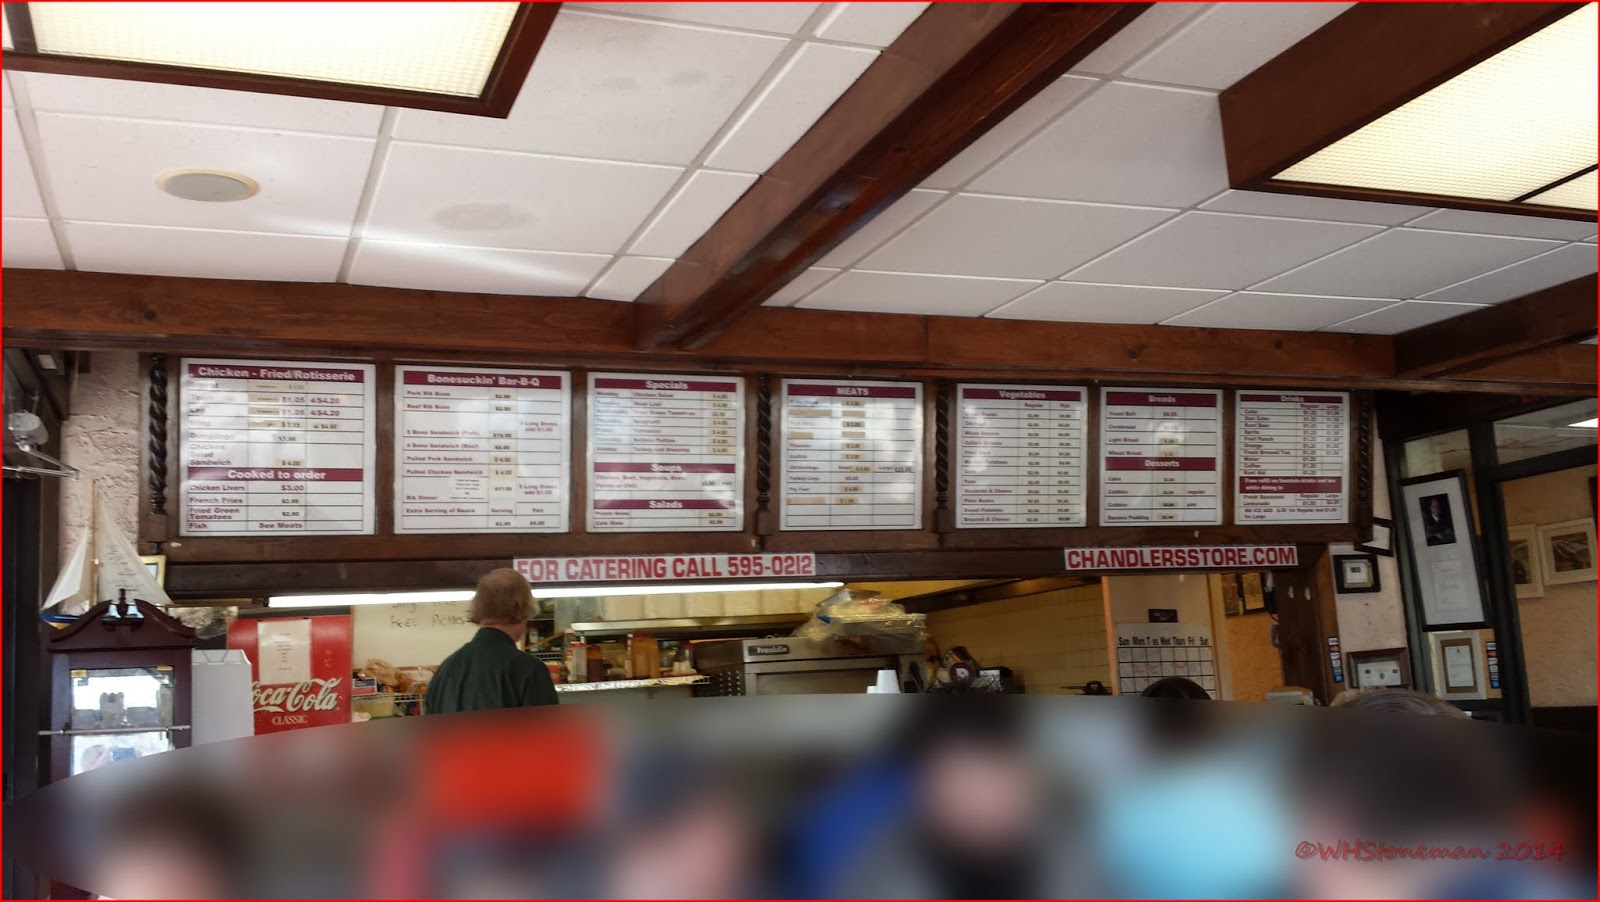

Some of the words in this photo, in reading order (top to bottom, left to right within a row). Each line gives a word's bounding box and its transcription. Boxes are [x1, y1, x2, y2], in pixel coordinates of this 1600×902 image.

[198, 367, 249, 377] Chicken
[260, 369, 355, 381] Fried/Rotisserie
[427, 374, 496, 384] Bonesuckin'
[498, 377, 540, 386] Bar-B-Q
[645, 380, 688, 390] Specials
[837, 387, 869, 396] MEATS
[999, 390, 1046, 399] Vegetables
[651, 464, 682, 472] Soups
[227, 470, 274, 479] Cooked
[278, 471, 290, 479] to
[293, 471, 326, 479] order
[1067, 548, 1295, 568] CHANDLERSSTORE.COM
[518, 559, 558, 581] FOR
[565, 558, 666, 580] CATERING
[672, 557, 722, 577] CALL
[727, 555, 813, 575] 595-0212
[1119, 637, 1130, 645] Sun
[1133, 637, 1145, 645] Mon
[1147, 637, 1159, 645] Tes
[1161, 637, 1170, 645] Wed
[1173, 636, 1185, 645] Thurs
[1188, 637, 1196, 645] Fri
[1200, 636, 1209, 645] Sat
[272, 715, 308, 725] CLASSIC
